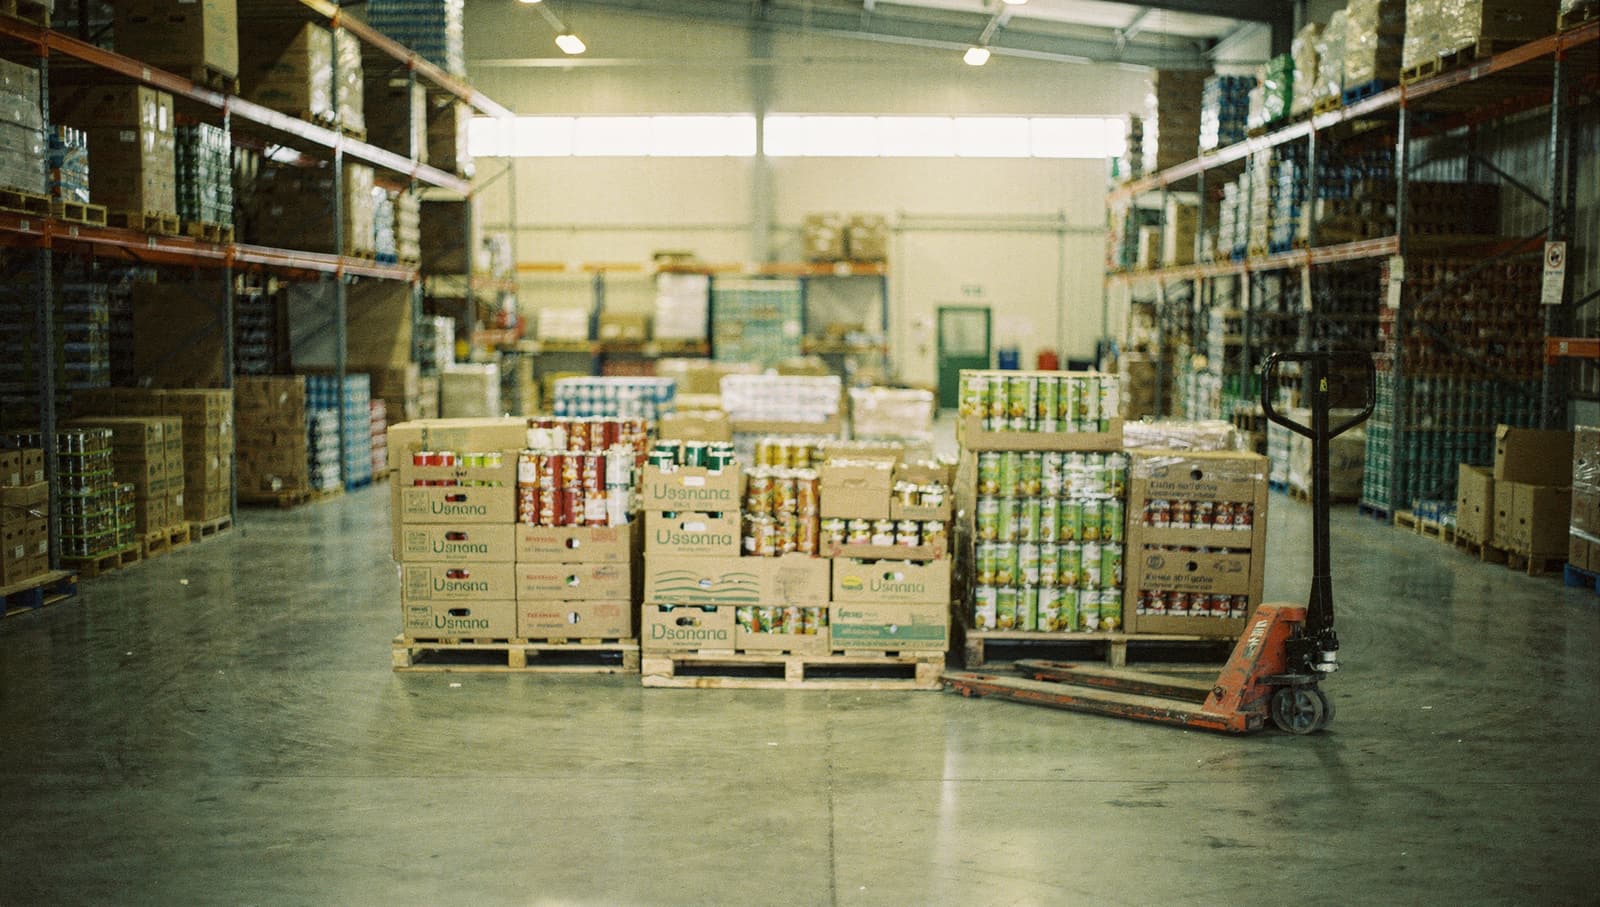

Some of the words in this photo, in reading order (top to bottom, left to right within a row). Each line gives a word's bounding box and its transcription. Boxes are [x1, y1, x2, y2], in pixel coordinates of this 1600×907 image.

[431, 501, 487, 515] Usnana
[432, 540, 488, 554] Usnana
[434, 615, 489, 629] Usnana
